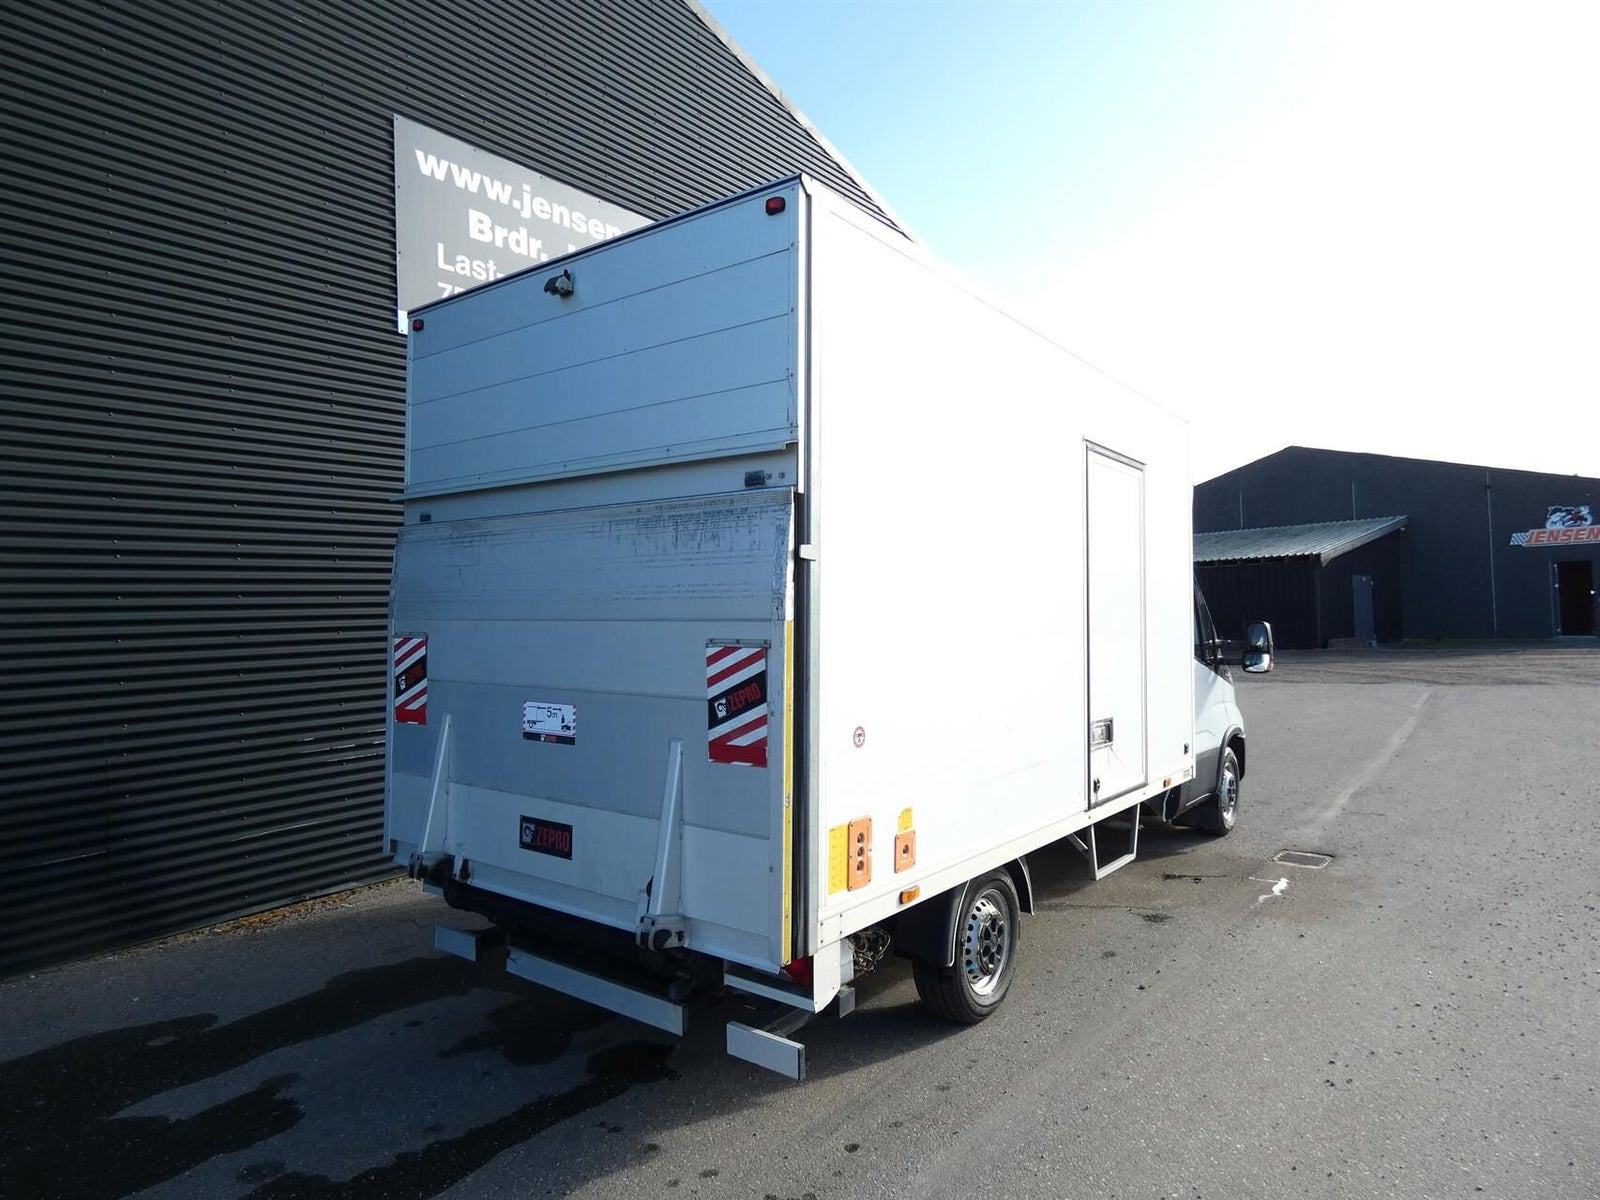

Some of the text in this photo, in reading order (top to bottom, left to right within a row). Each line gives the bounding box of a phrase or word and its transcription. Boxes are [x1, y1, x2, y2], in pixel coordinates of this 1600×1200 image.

[468, 209, 549, 262] Brdr.
[1524, 527, 1600, 545] JENSEN
[728, 683, 760, 711] ZEPRO
[536, 826, 570, 852] ZEPRO
